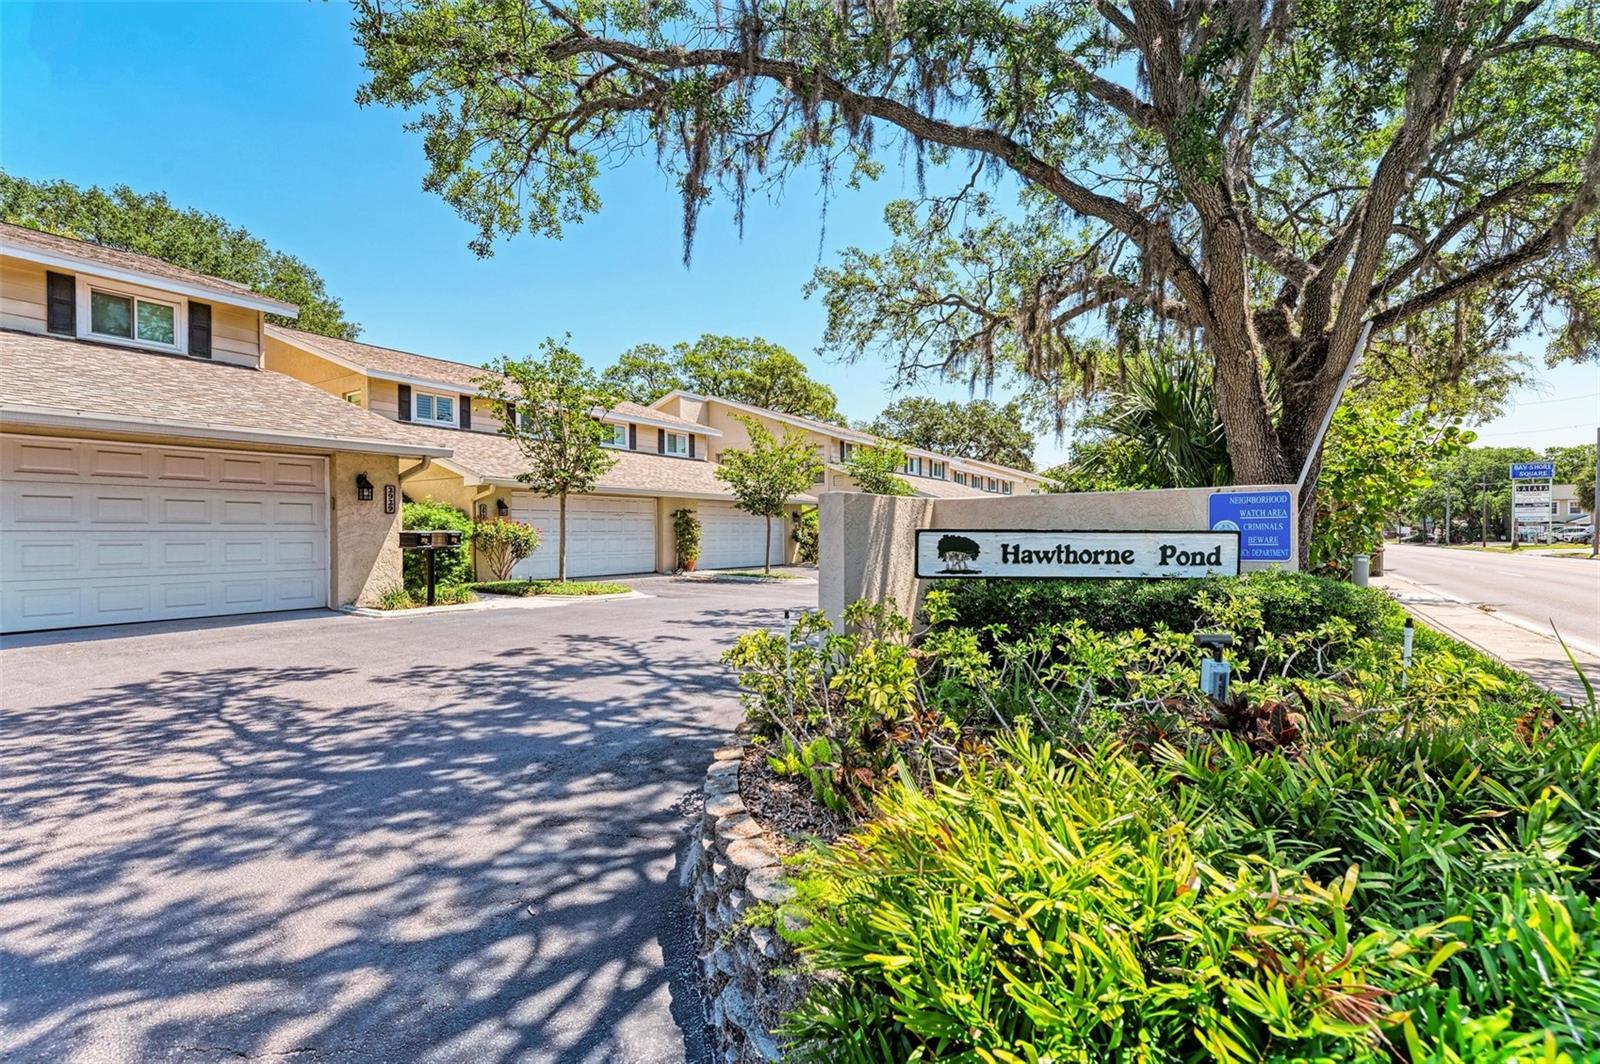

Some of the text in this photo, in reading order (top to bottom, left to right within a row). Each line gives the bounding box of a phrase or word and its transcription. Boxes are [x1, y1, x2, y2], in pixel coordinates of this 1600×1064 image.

[1229, 495, 1288, 505] NEIGHBORHOOD
[1240, 509, 1288, 517] WATCH AREA
[1243, 523, 1284, 531] CRIMINALS
[1247, 535, 1279, 544] BEWARE
[1000, 543, 1223, 566] Hawthorne Pond
[1251, 548, 1289, 557] DEPARTMENT
